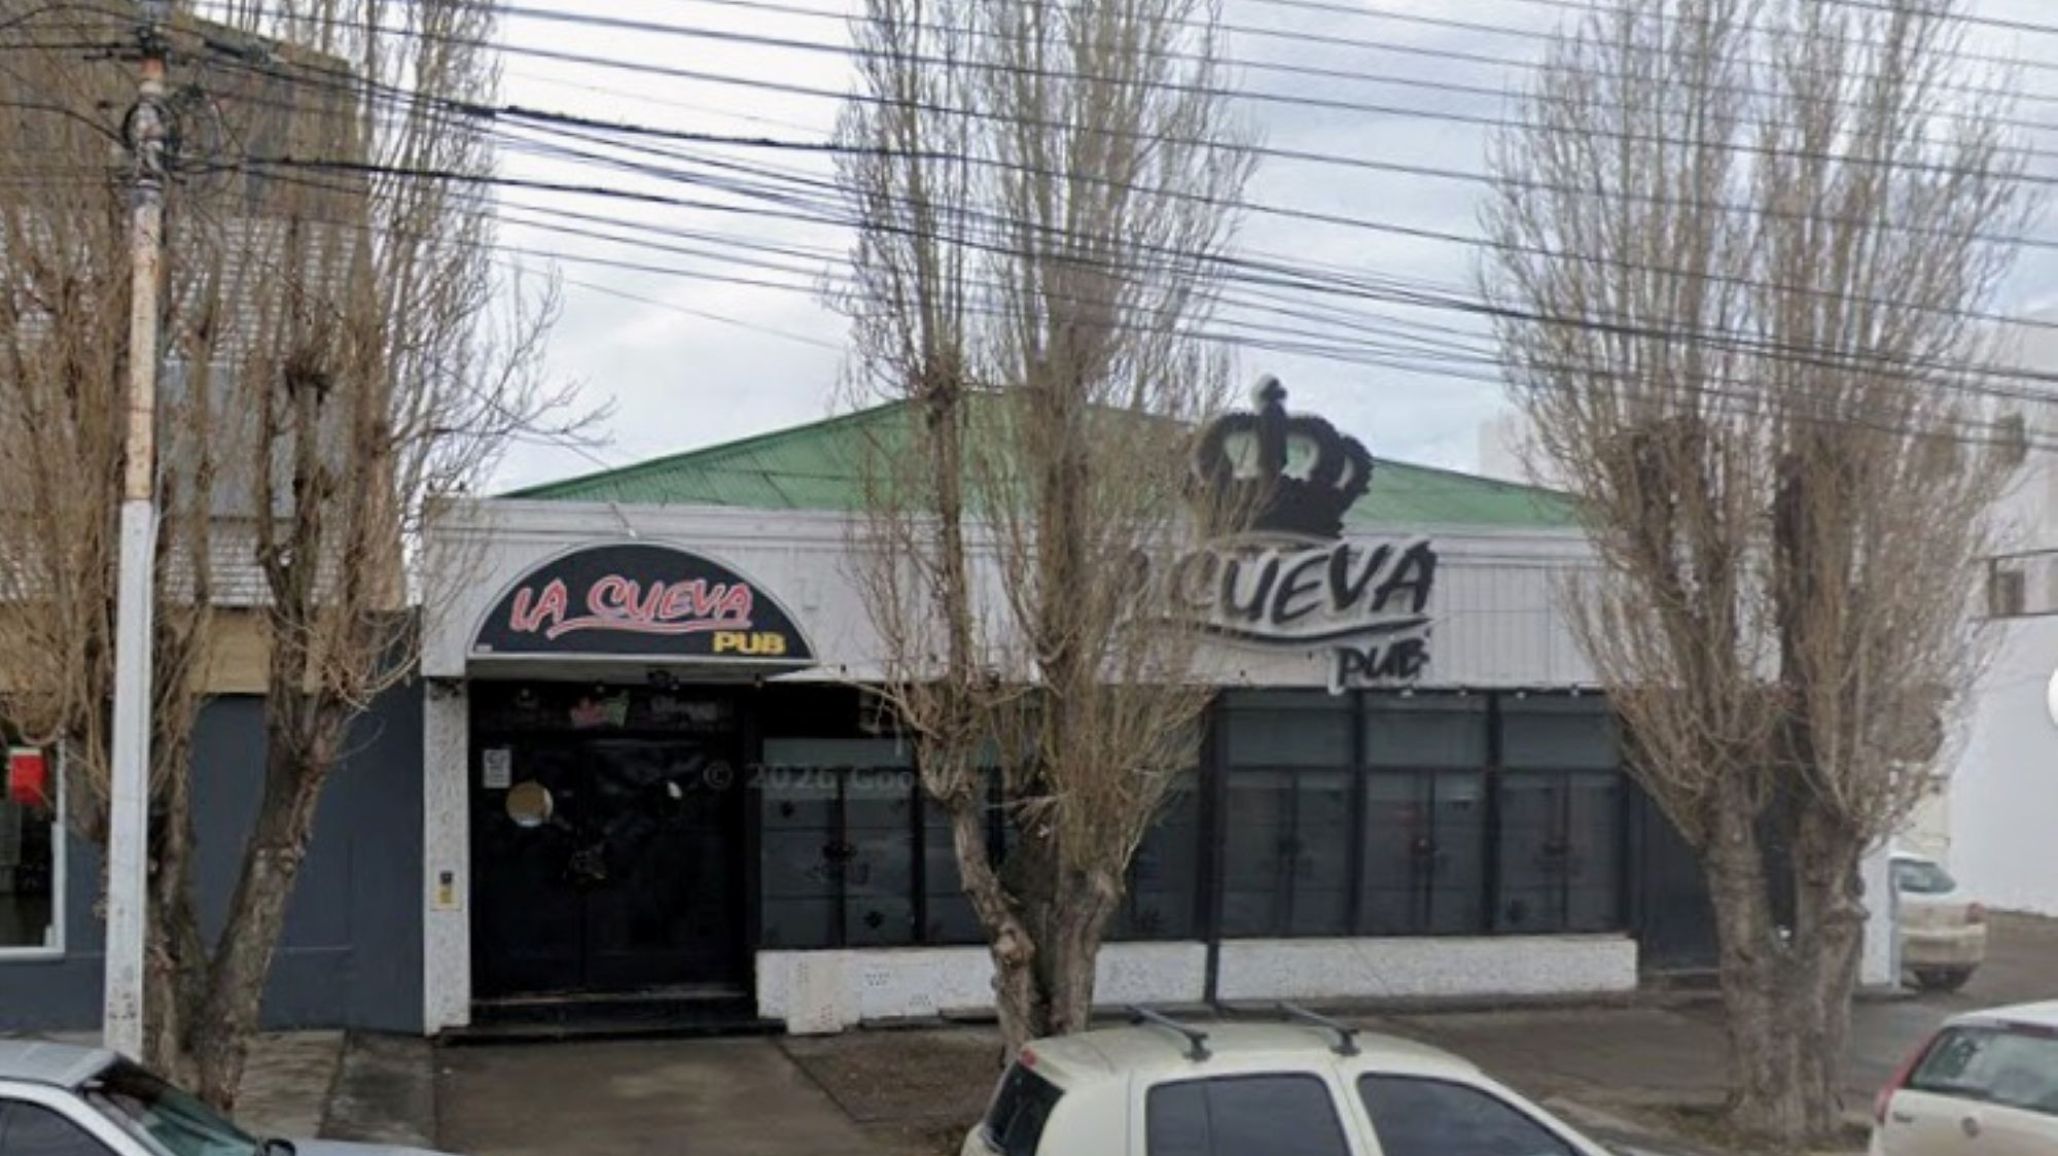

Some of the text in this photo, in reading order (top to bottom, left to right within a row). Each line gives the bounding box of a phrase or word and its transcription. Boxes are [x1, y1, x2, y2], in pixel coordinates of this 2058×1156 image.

[509, 574, 753, 632] LA CUEVA
[1168, 538, 1437, 624] CUEVA
[712, 632, 786, 655] PUB
[1334, 636, 1432, 691] PUB
